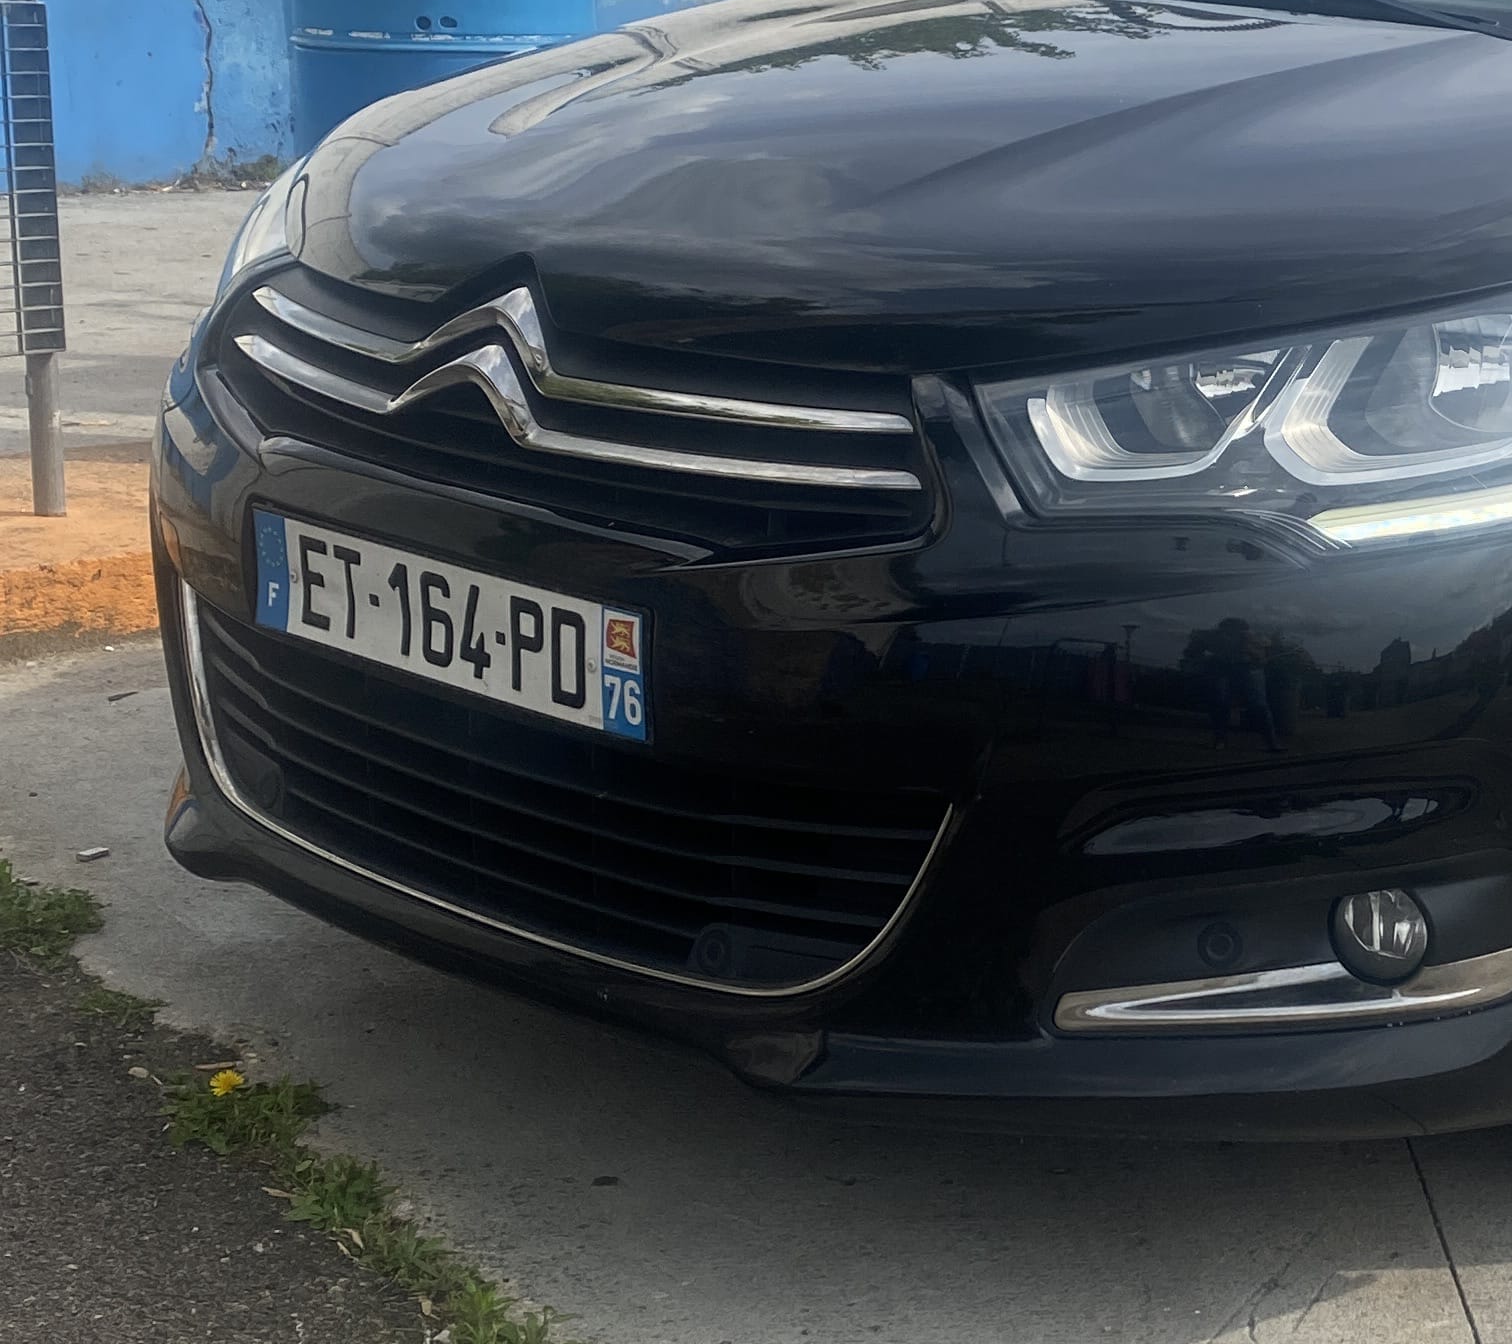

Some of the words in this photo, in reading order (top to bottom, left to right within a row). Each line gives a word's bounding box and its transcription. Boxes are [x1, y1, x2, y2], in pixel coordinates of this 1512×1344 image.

[268, 581, 280, 607] F
[300, 534, 586, 709] ET-164-PD
[604, 674, 641, 725] 76
